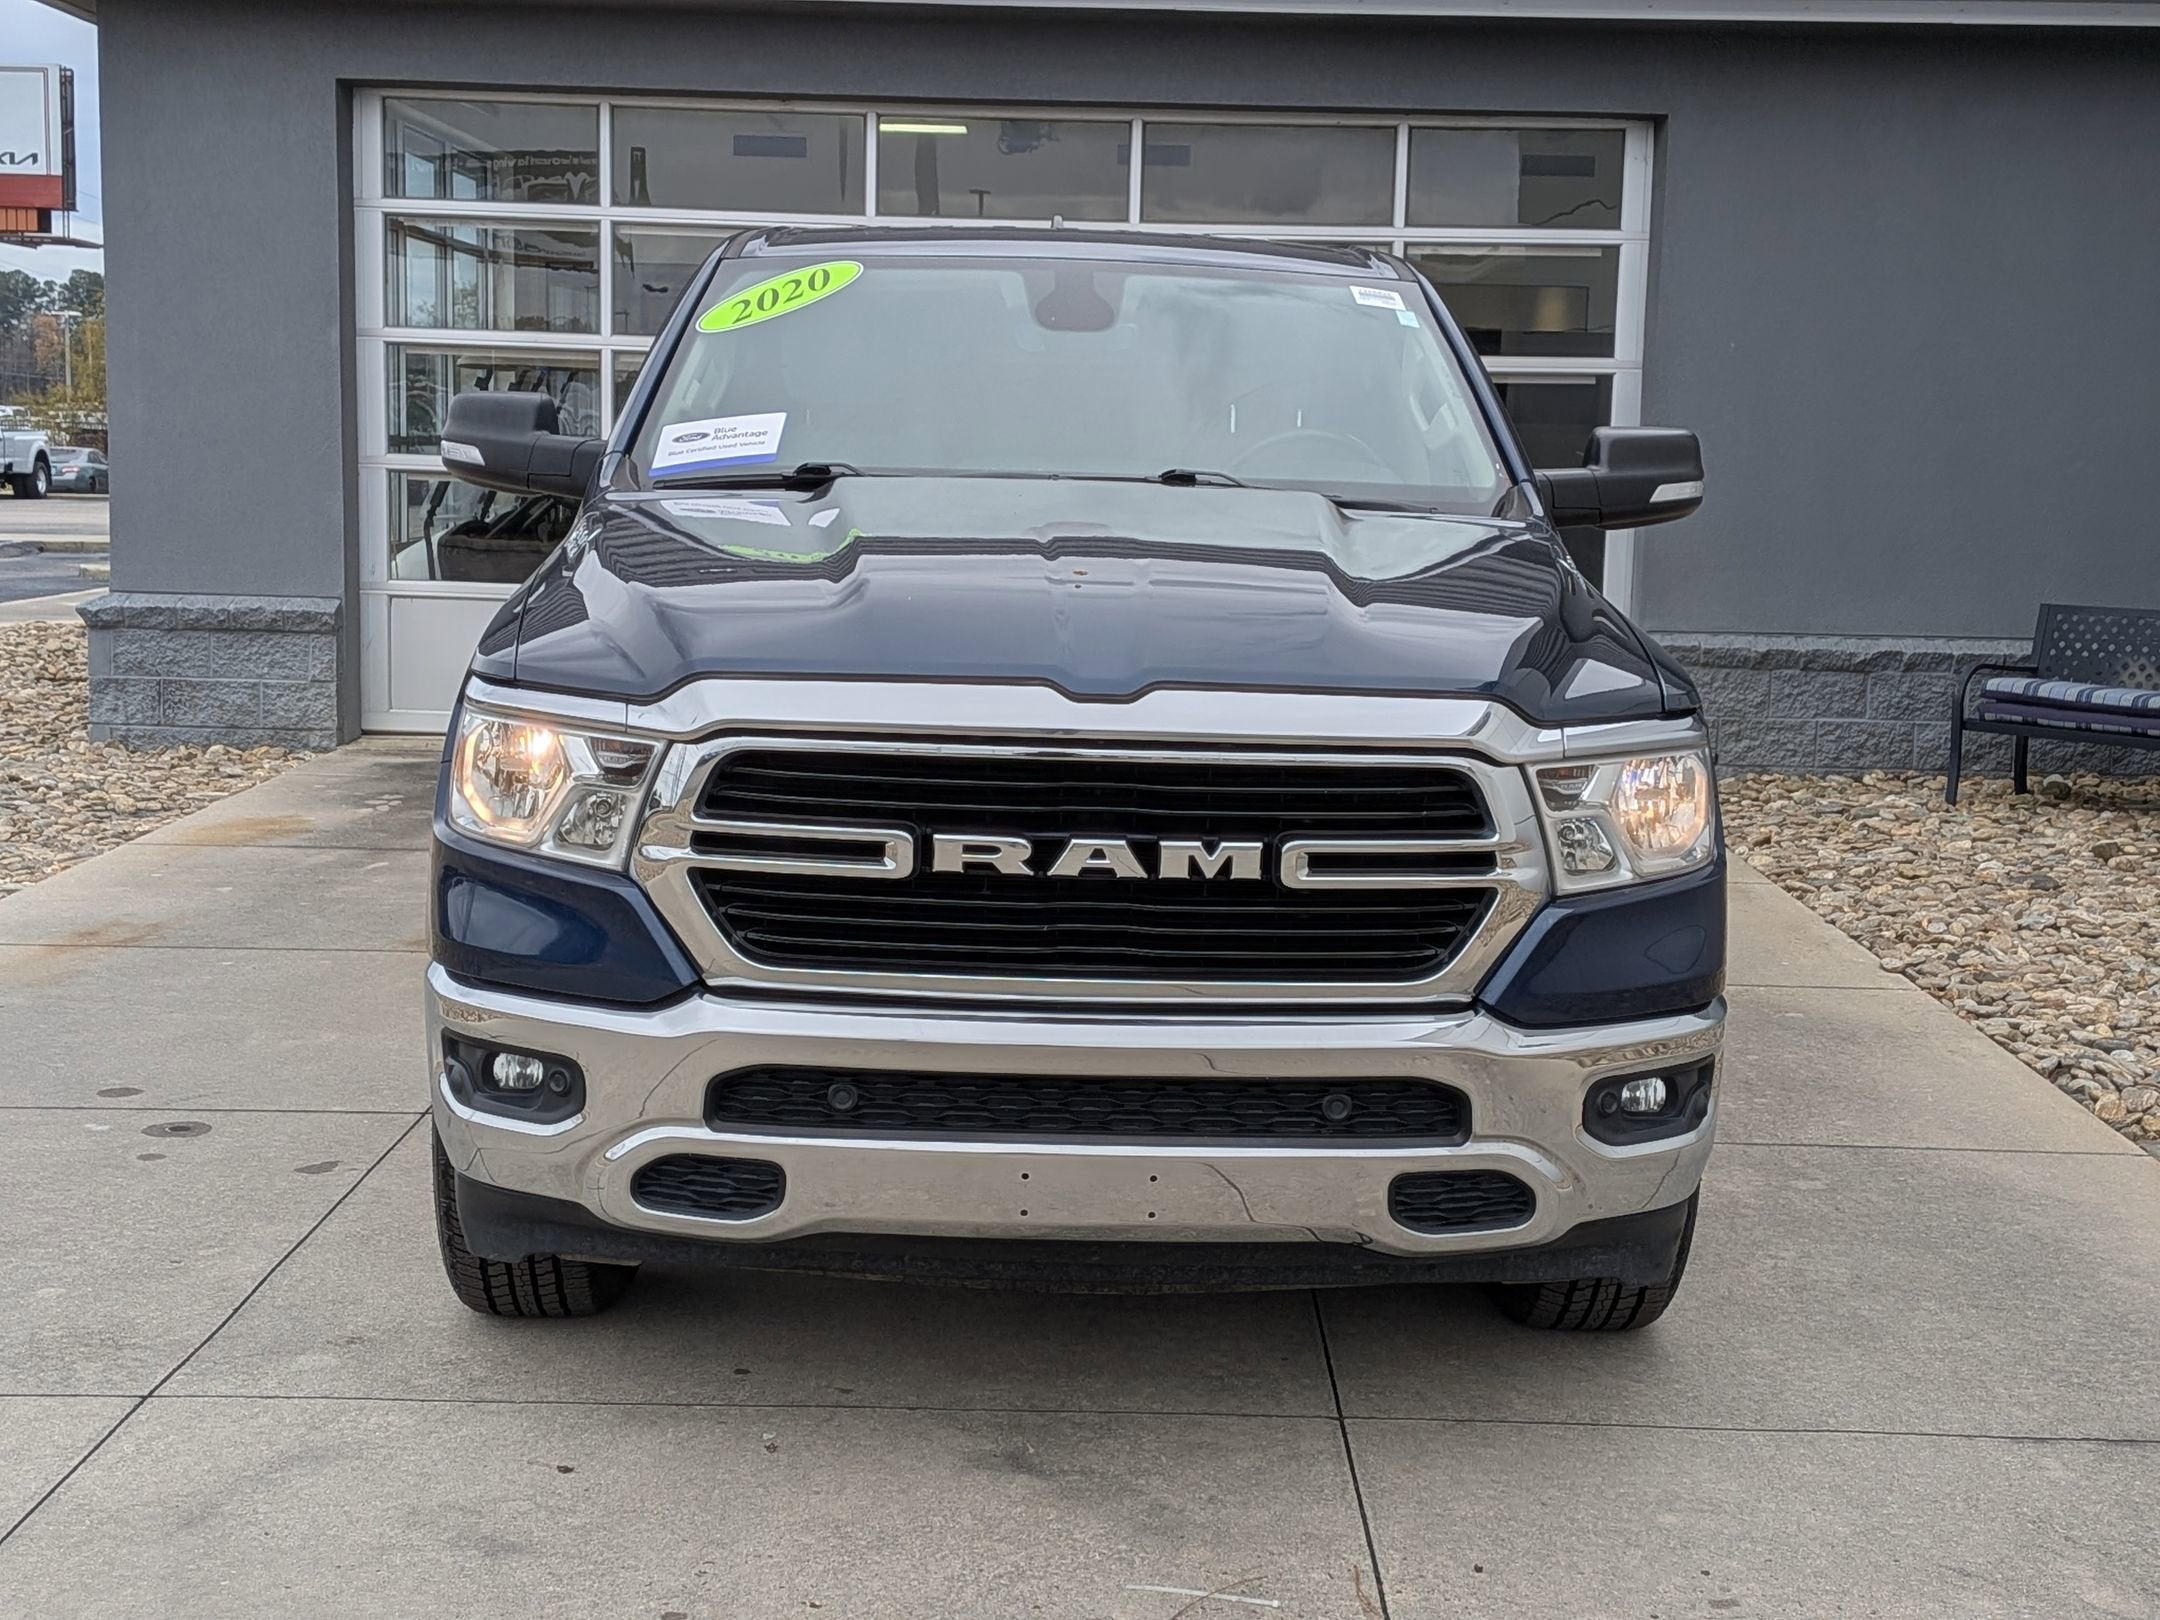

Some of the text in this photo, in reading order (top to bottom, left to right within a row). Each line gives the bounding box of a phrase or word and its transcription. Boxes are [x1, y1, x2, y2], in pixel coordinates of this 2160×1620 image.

[731, 268, 831, 325] 2020
[712, 430, 768, 441] Advantage
[714, 426, 737, 434] Blue
[932, 833, 1264, 880] RAM
